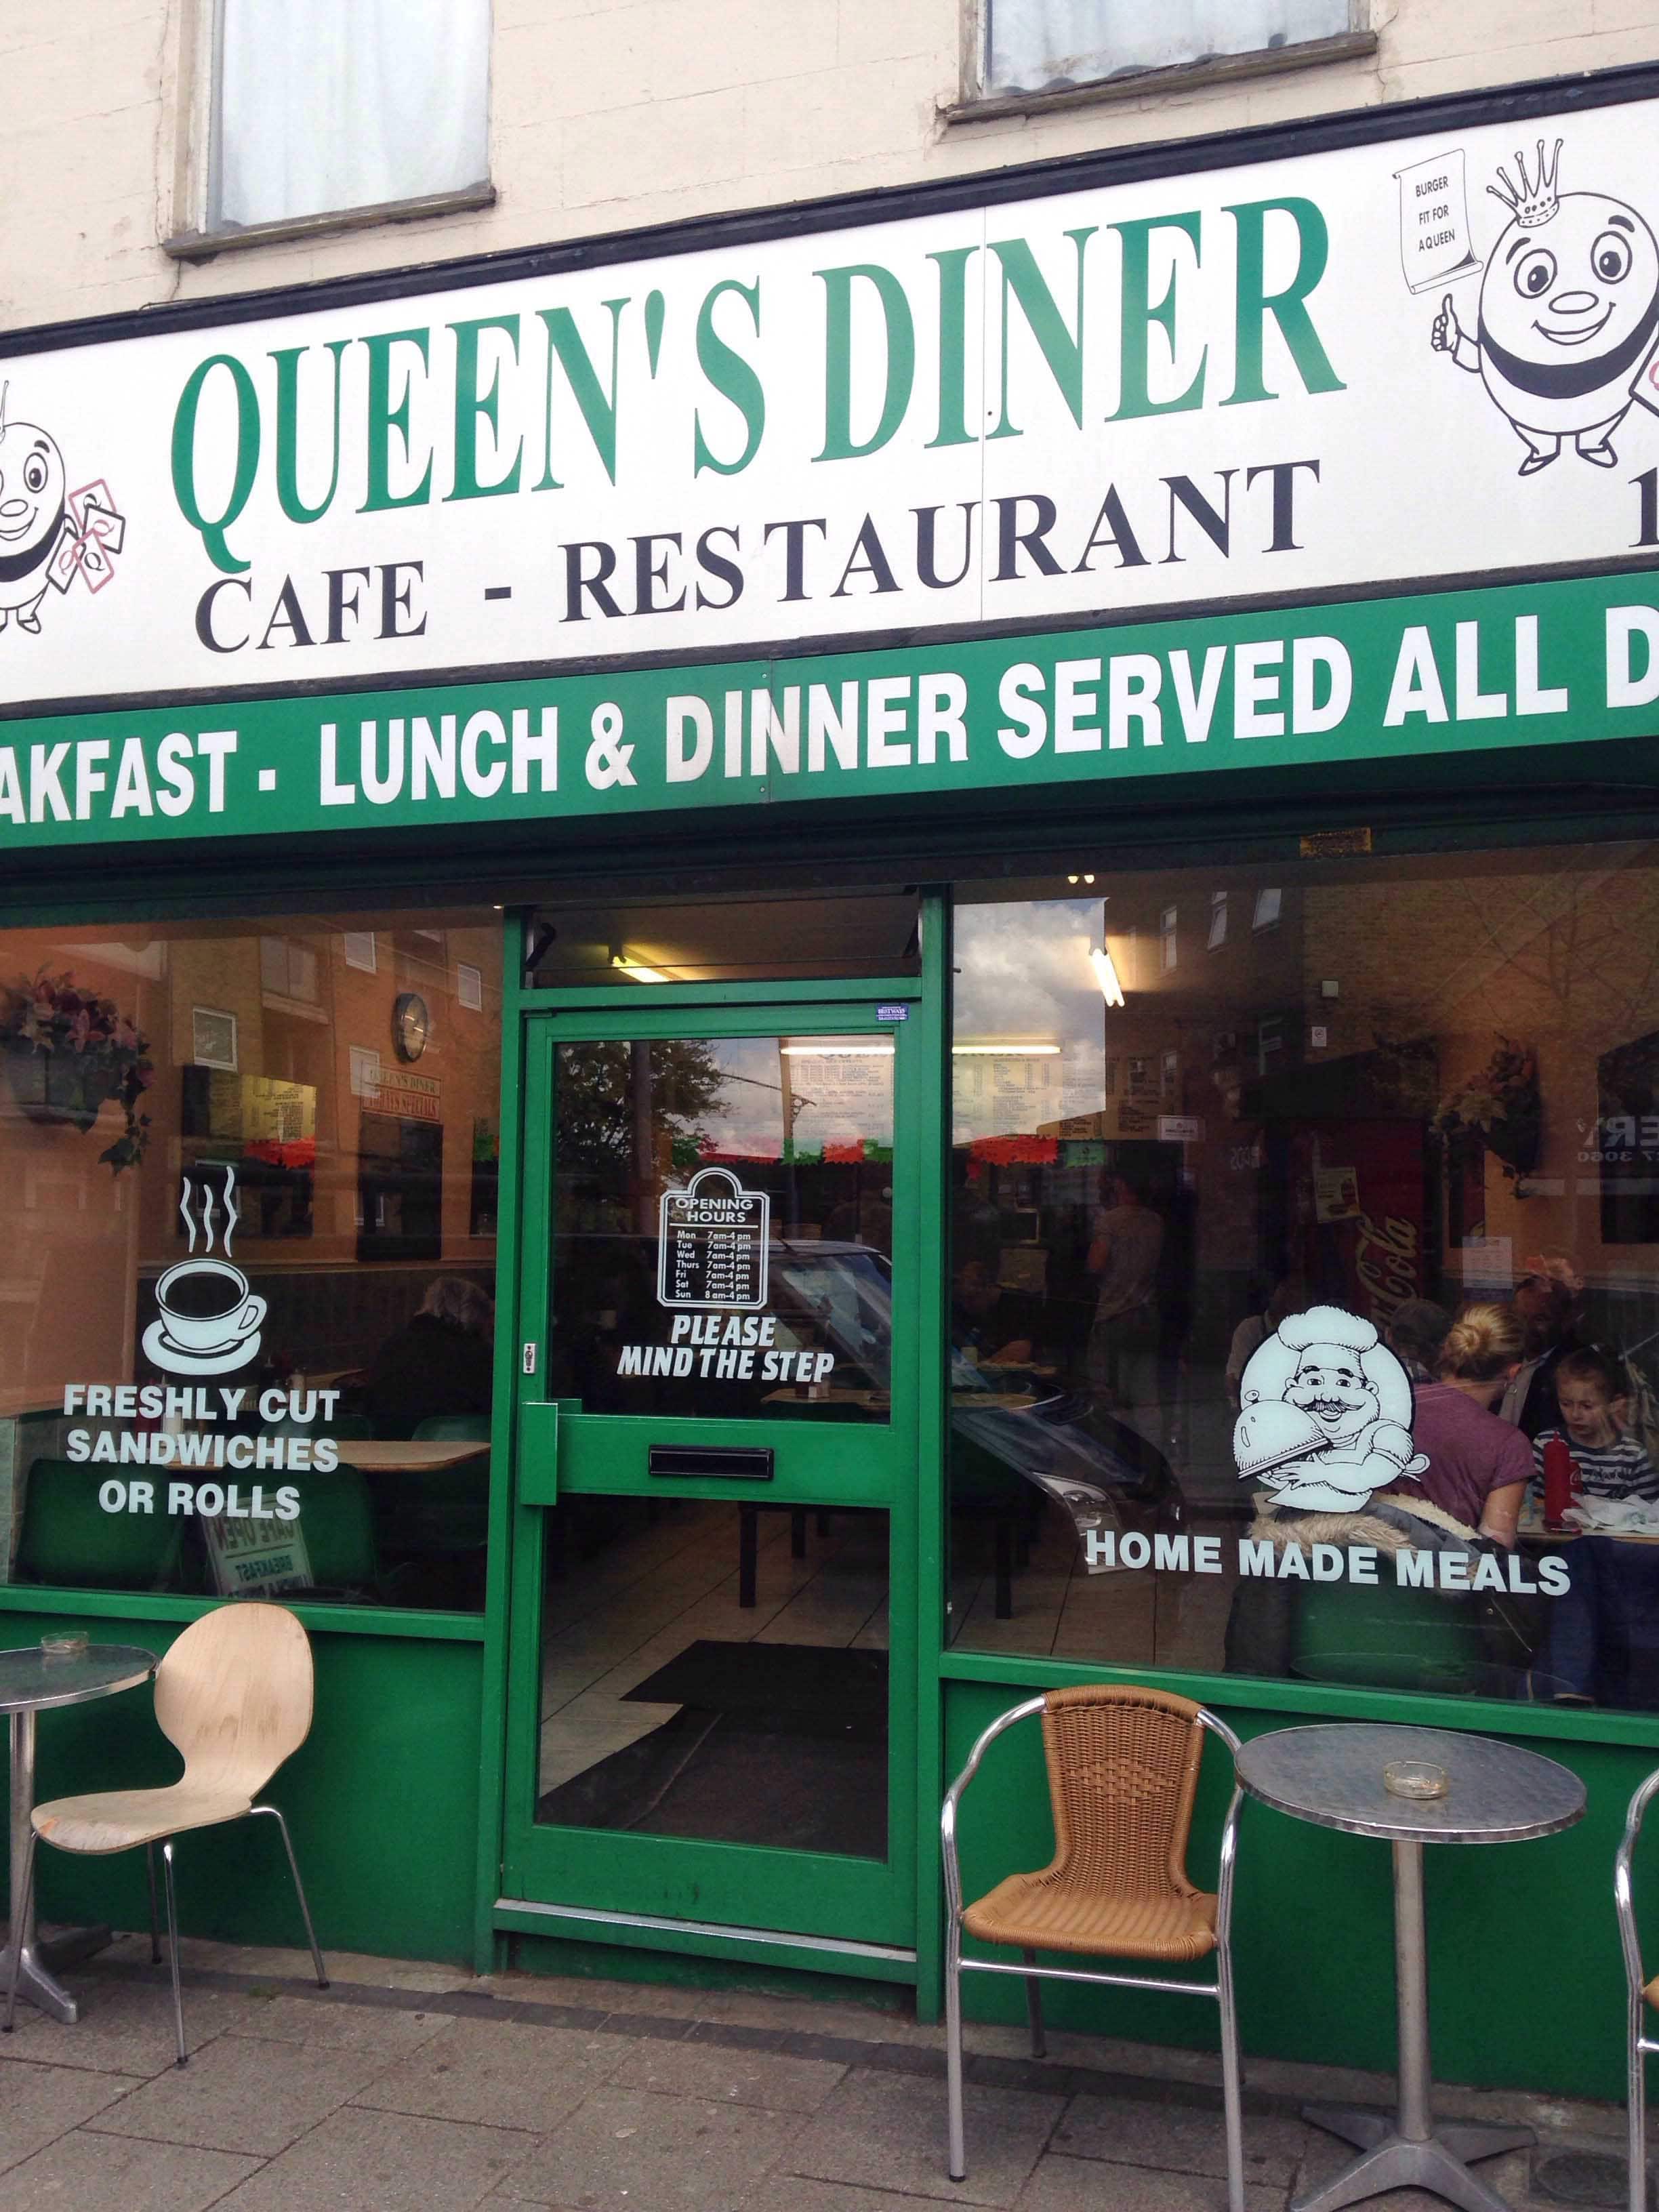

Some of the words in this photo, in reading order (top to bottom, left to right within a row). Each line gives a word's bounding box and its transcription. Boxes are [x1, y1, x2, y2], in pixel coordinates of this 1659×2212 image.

[1415, 176, 1449, 197] BURGER
[1418, 211, 1430, 226] FIT
[1433, 204, 1450, 222] FOR
[1418, 239, 1425, 252] A
[1425, 228, 1456, 249] QUEEN
[171, 275, 766, 574] QUEEN'S
[811, 197, 1347, 462] DINER
[194, 560, 428, 653] CAFE
[559, 459, 1320, 623] RESTAURANT
[320, 705, 559, 806] LUNCH
[585, 701, 637, 790] &
[666, 672, 969, 783] DINNER
[998, 635, 1353, 760] SERVED
[1382, 614, 1568, 727] ALL
[675, 1197, 754, 1210] OPENING
[687, 1211, 746, 1223] HOURS
[676, 1240, 692, 1249] Tue
[737, 1244, 751, 1252] pm
[677, 1230, 697, 1240] Mon
[737, 1233, 751, 1242] pm
[676, 1250, 695, 1259] Wed
[736, 1253, 750, 1261] pm
[676, 1260, 699, 1269] Thurs
[737, 1263, 751, 1271] pm
[675, 1269, 687, 1279] Fri
[735, 1273, 750, 1282] pm
[675, 1279, 689, 1288] Sat
[736, 1283, 750, 1291] pm
[675, 1289, 691, 1298] Sun
[705, 1290, 710, 1298] 8
[736, 1293, 750, 1302] pm
[670, 1315, 777, 1347] PLEASE
[617, 1345, 693, 1377] MIND
[699, 1347, 756, 1380] THE
[761, 1350, 835, 1382] STEP
[64, 1384, 246, 1421] FRESHLY
[259, 1388, 340, 1424] CUT
[66, 1428, 339, 1473] SANDWICHES
[99, 1479, 155, 1515] OR
[168, 1481, 301, 1521] ROLLS
[1086, 1530, 1223, 1574] HOME
[1238, 1538, 1379, 1585] MADE
[1397, 1549, 1571, 1597] MEALS
